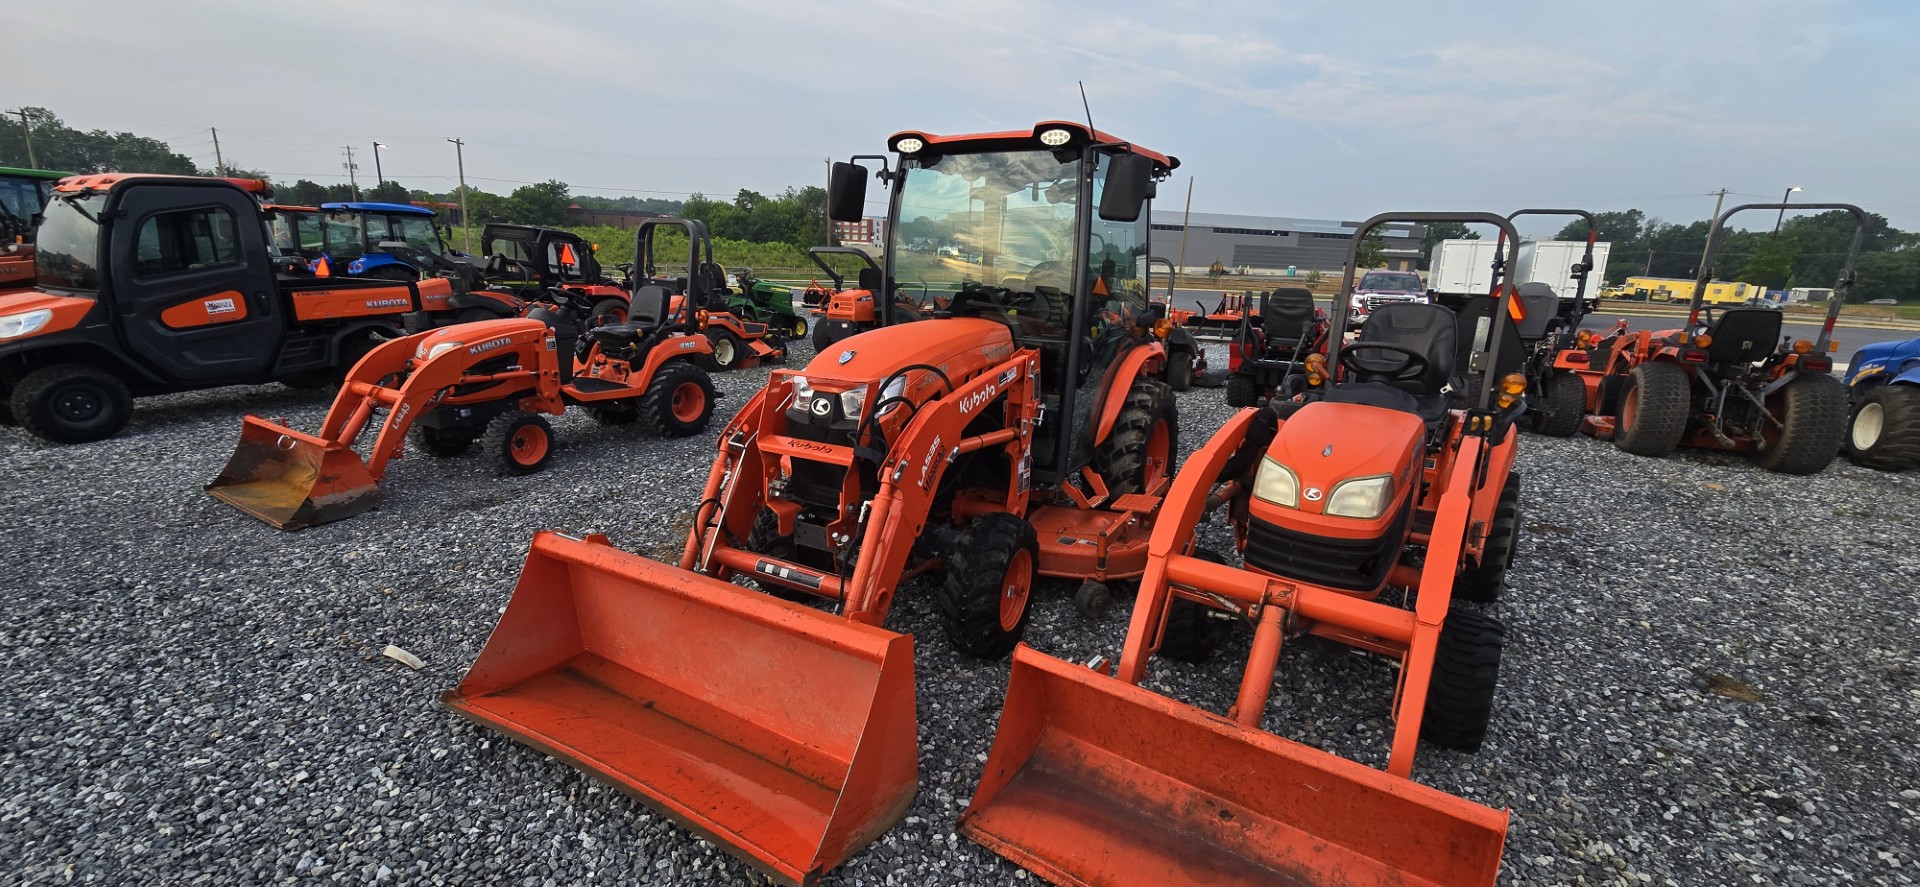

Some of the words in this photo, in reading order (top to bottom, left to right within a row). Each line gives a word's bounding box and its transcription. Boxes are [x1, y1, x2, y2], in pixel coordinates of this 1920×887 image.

[366, 298, 409, 308] KUBOTA
[469, 337, 513, 355] KUBOTA
[679, 341, 696, 349] 4WD
[960, 384, 996, 414] Kubota
[392, 402, 411, 430] LA243
[788, 439, 833, 454] Kubota
[917, 434, 941, 487] LA535
